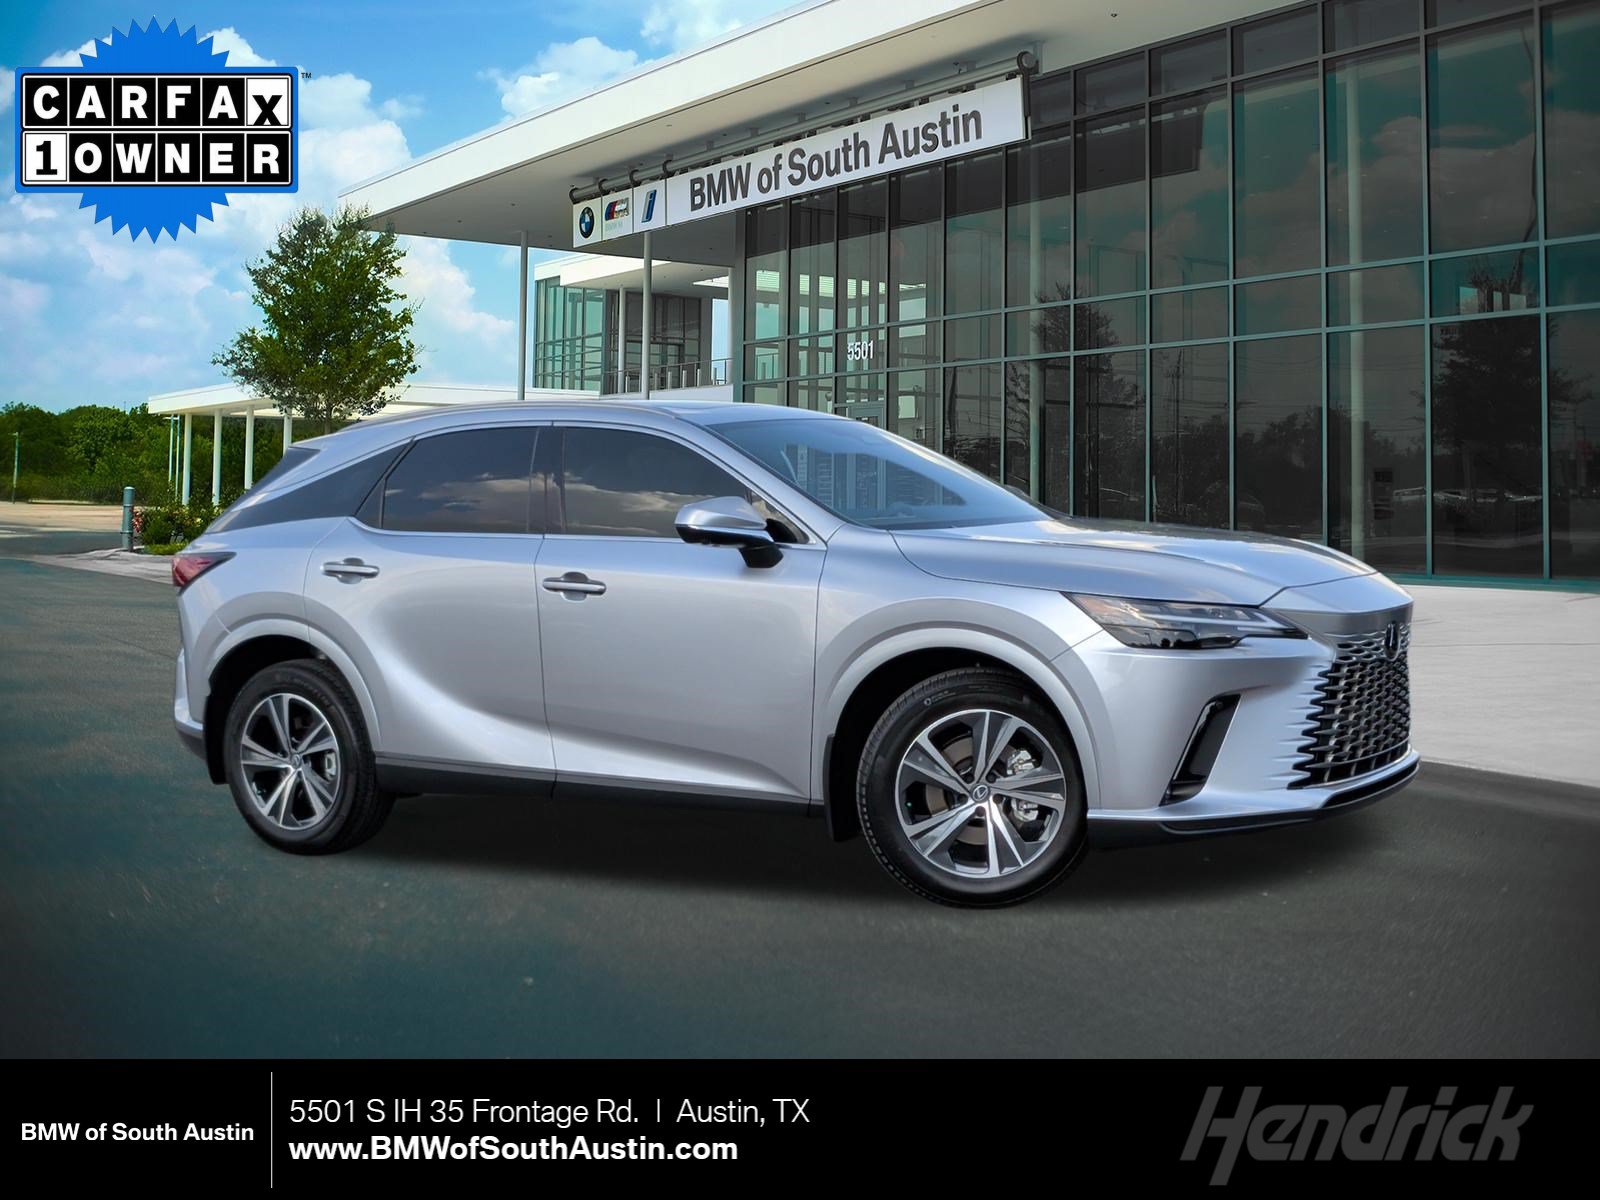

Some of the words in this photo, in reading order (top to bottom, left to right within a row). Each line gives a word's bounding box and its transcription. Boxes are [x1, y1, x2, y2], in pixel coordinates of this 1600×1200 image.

[690, 162, 751, 212] BMW
[757, 153, 783, 194] of
[787, 132, 870, 186] South
[878, 104, 982, 164] Austin
[847, 340, 874, 360] 5501
